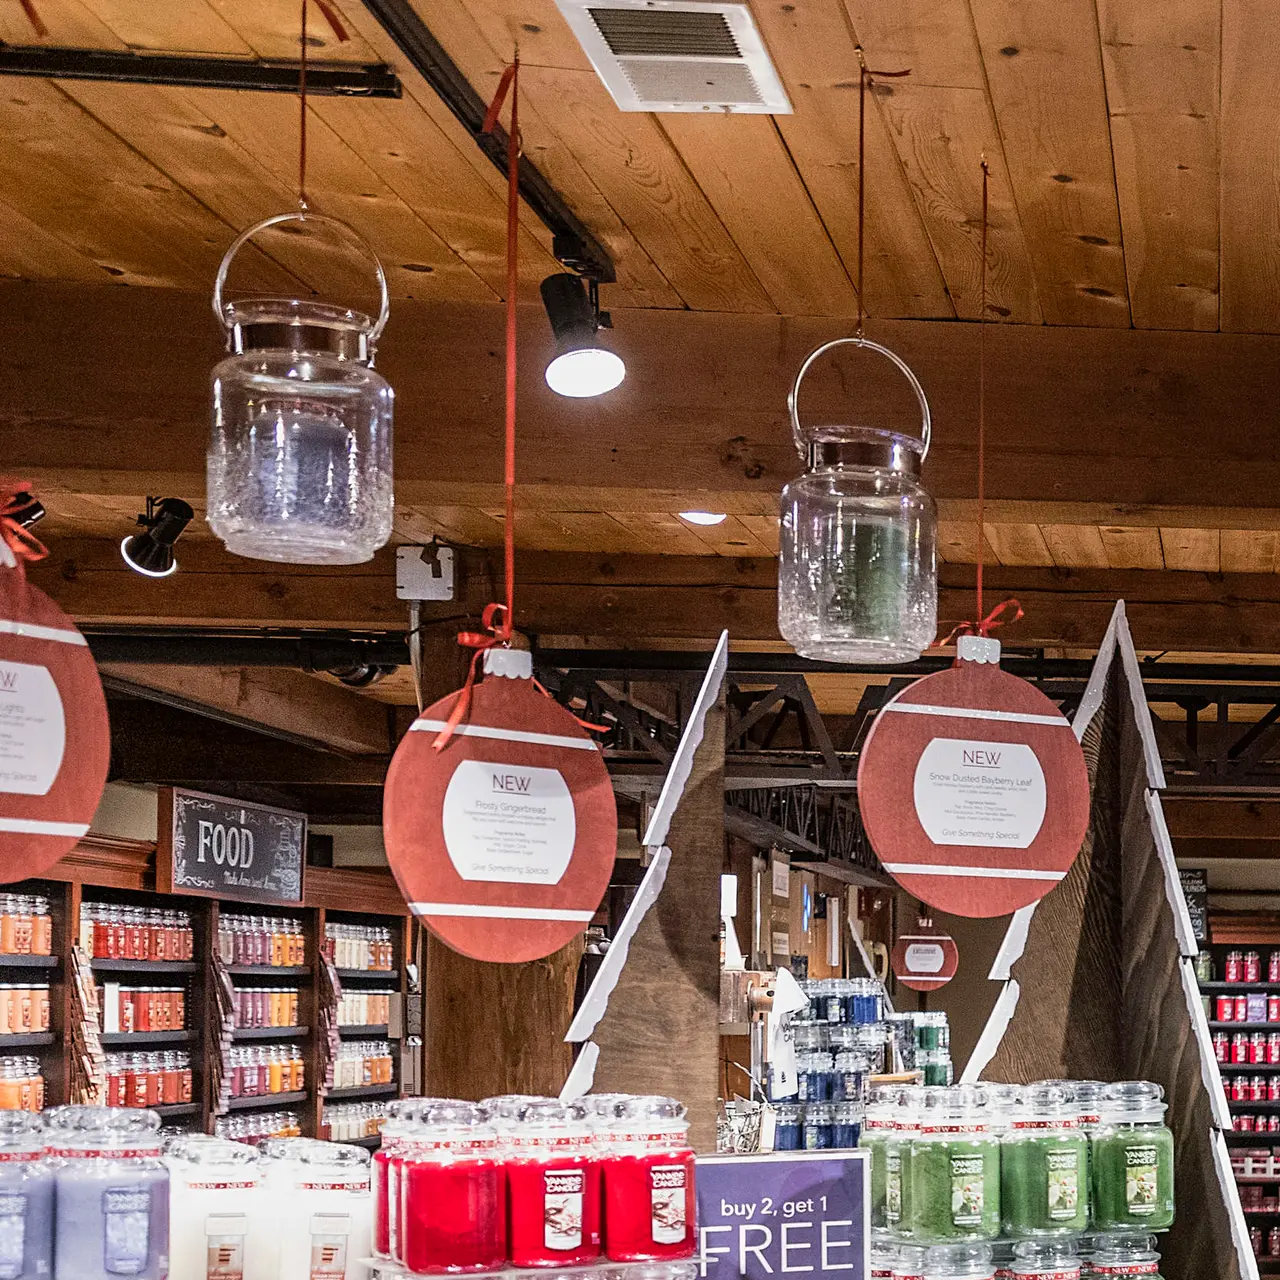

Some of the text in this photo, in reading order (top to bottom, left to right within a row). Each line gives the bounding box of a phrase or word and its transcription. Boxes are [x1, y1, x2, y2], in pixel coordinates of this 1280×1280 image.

[963, 749, 1002, 766] NEW
[492, 773, 532, 792] NEW
[930, 772, 1033, 788] Snow Dusted Bayberry Leaf
[475, 800, 547, 815] Frosty Gingerbread
[942, 828, 1021, 841] Give Something Special
[197, 820, 254, 868] FOOD
[720, 1196, 828, 1220] buy 2, get 1
[700, 1220, 854, 1277] FREE
[1138, 1264, 1153, 1273] NEW
